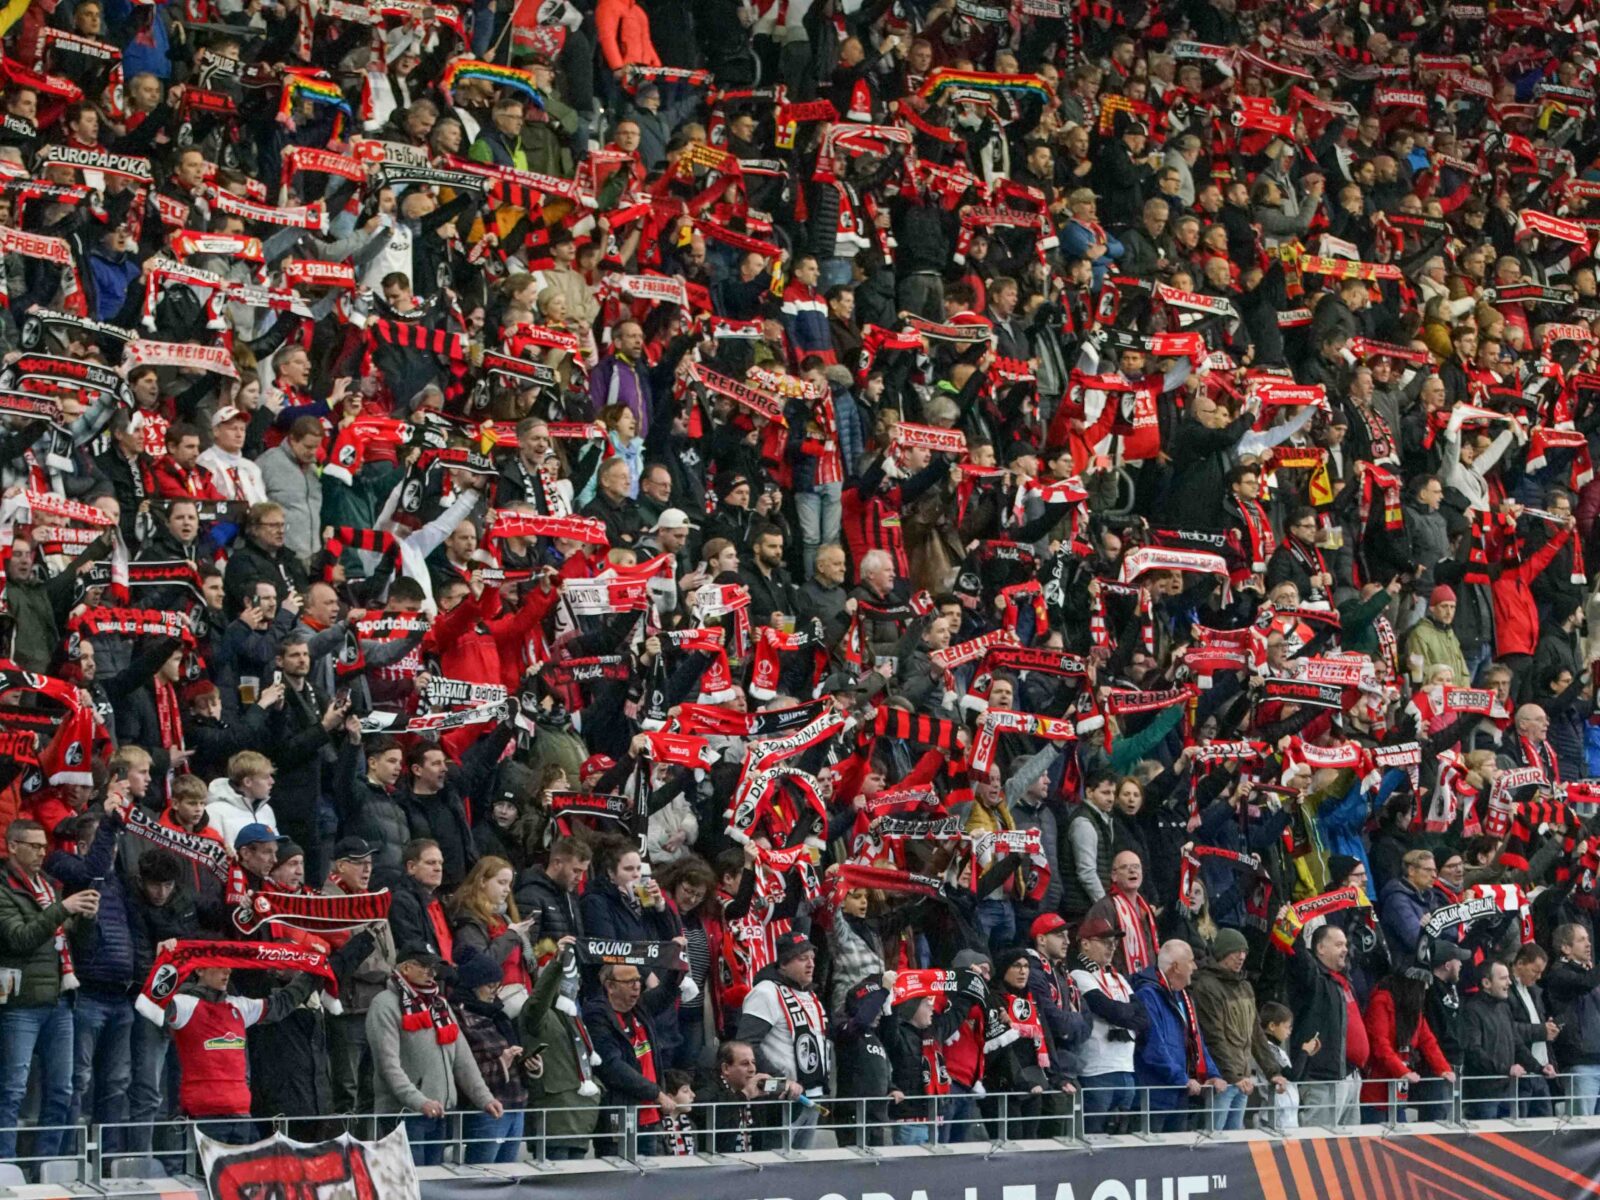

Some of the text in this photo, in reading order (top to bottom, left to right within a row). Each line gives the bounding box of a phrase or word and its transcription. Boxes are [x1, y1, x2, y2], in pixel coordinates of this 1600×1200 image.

[145, 344, 162, 357] SC
[1430, 896, 1495, 930] BERLIN BERLIN
[172, 945, 321, 969] sportclubfreiburg
[587, 940, 660, 958] ROUND 16
